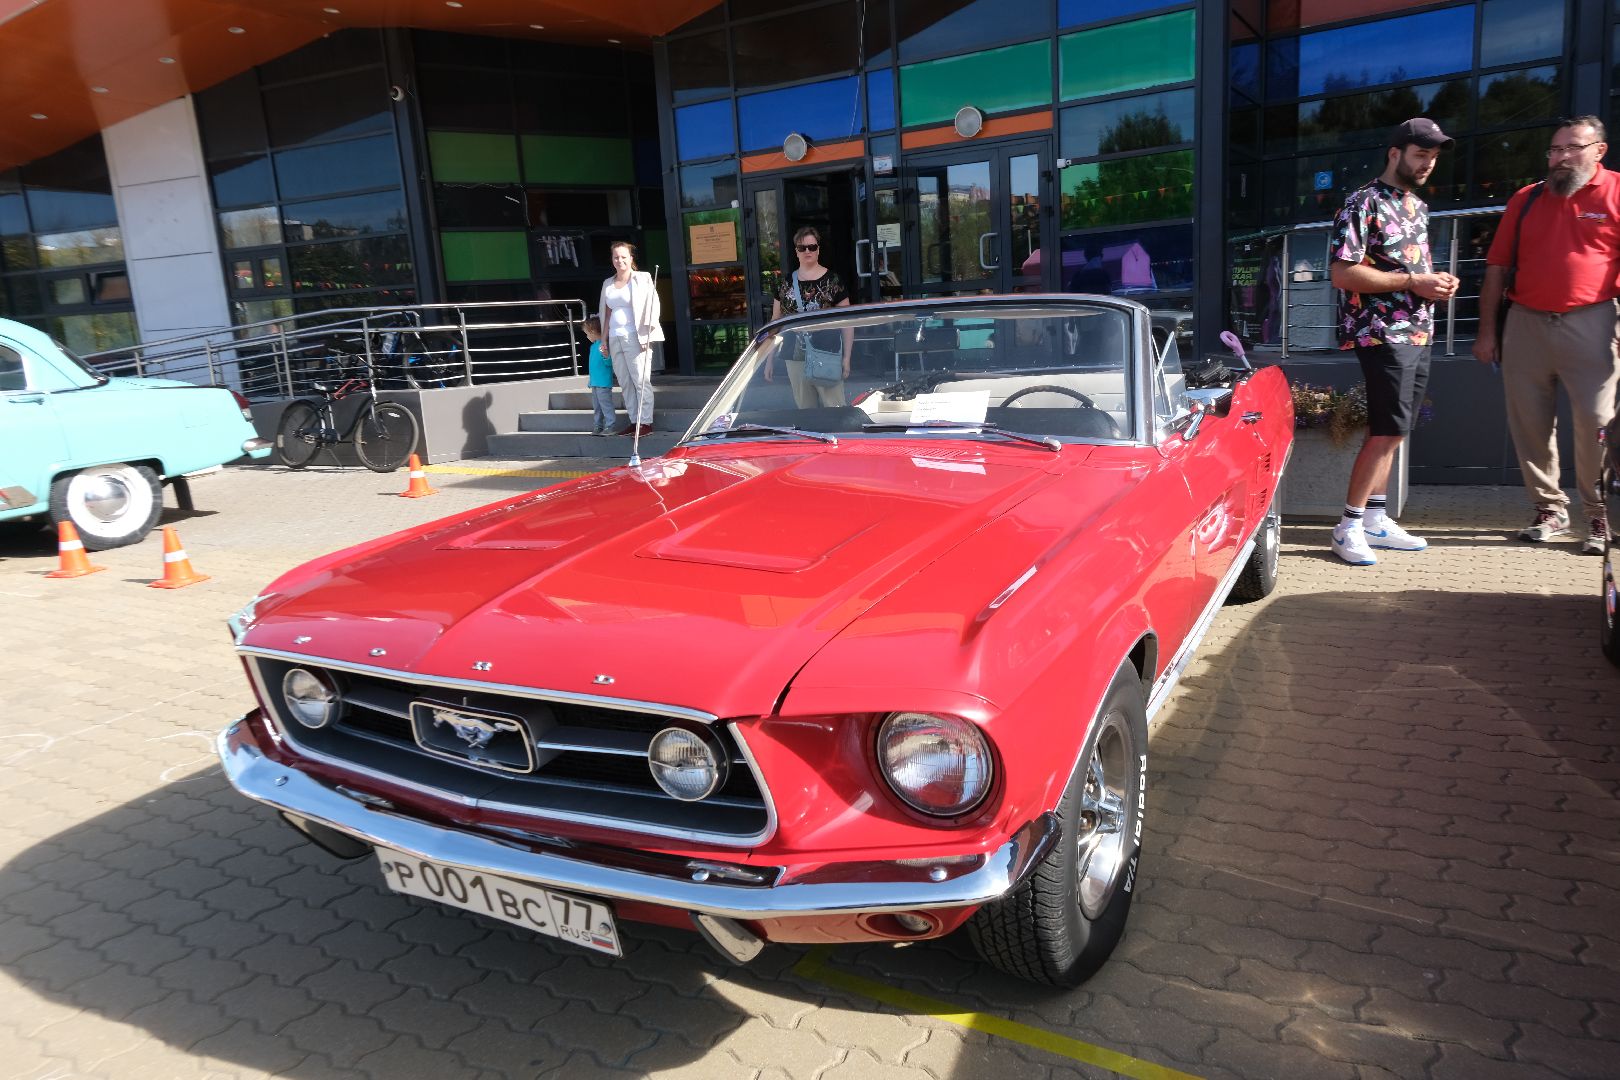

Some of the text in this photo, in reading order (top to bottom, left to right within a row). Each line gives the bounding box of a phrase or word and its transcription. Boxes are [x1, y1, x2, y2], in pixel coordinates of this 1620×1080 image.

[1133, 754, 1146, 847] Radial
[1123, 857, 1138, 893] T/A
[551, 894, 592, 931] 77
[560, 925, 591, 942] RUS
